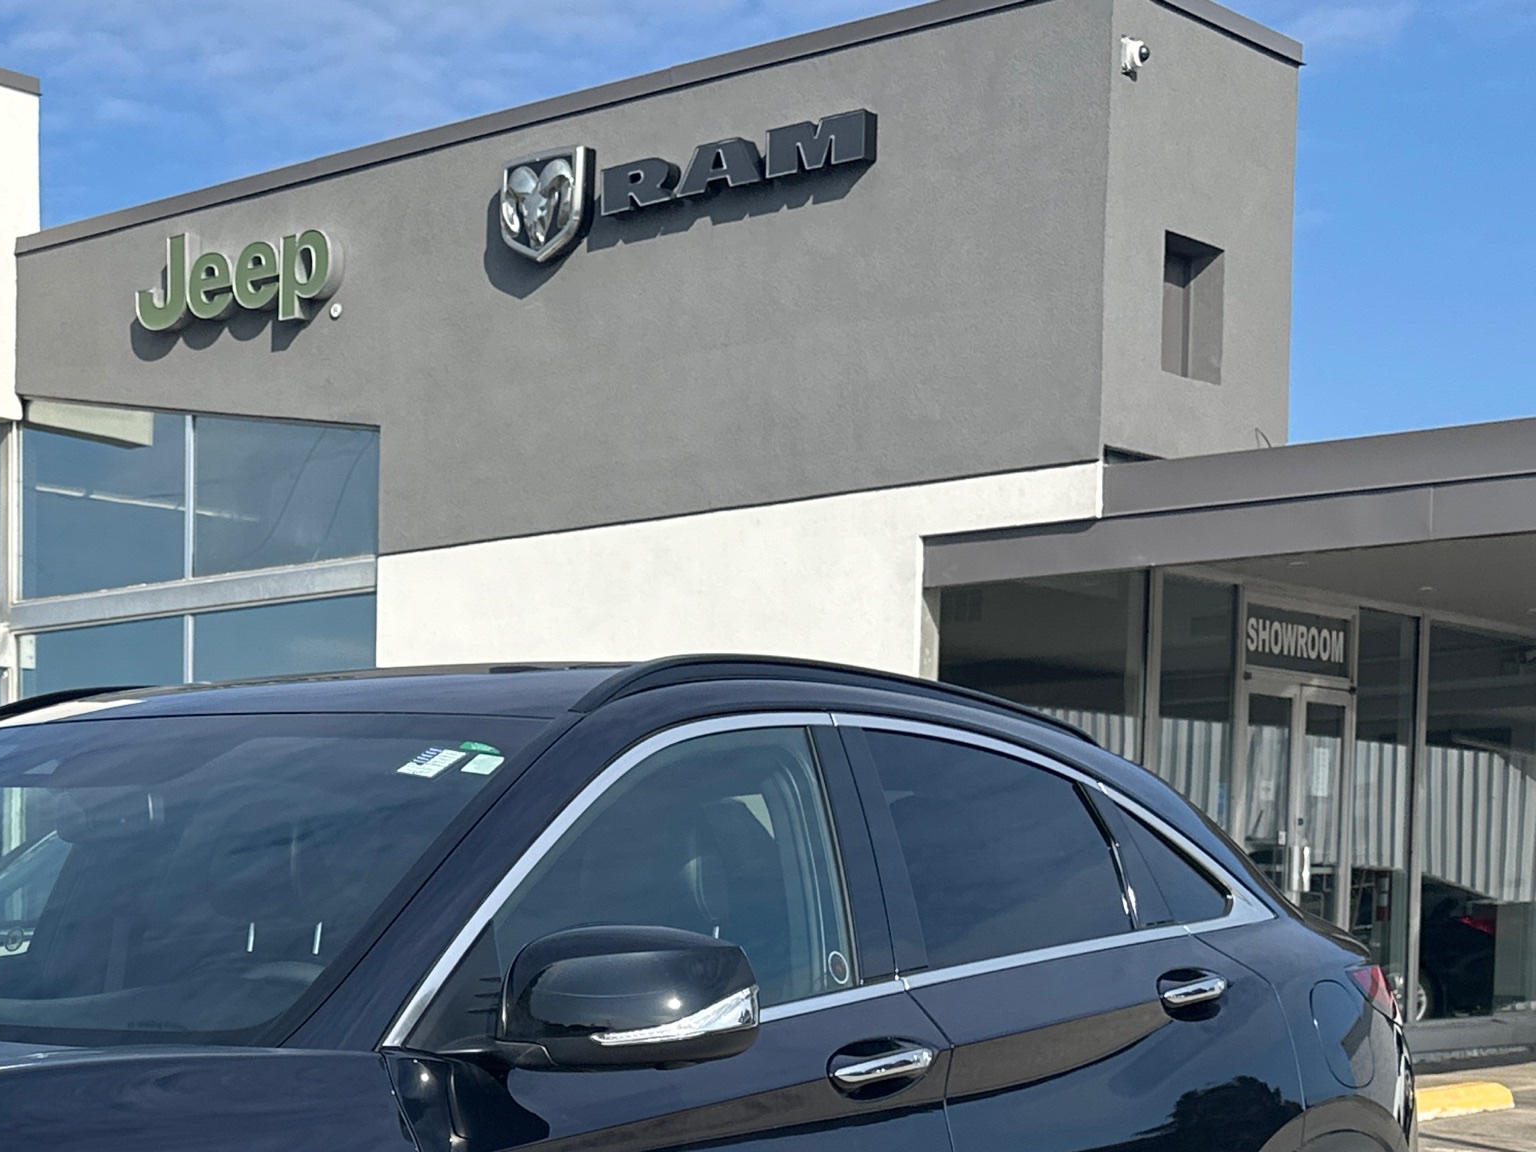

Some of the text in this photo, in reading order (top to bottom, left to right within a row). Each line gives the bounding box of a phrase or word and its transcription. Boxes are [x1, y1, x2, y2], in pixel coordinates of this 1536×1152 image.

[601, 109, 877, 216] RAM
[135, 229, 339, 332] Jeep
[1246, 616, 1345, 664] SHOWROOM
